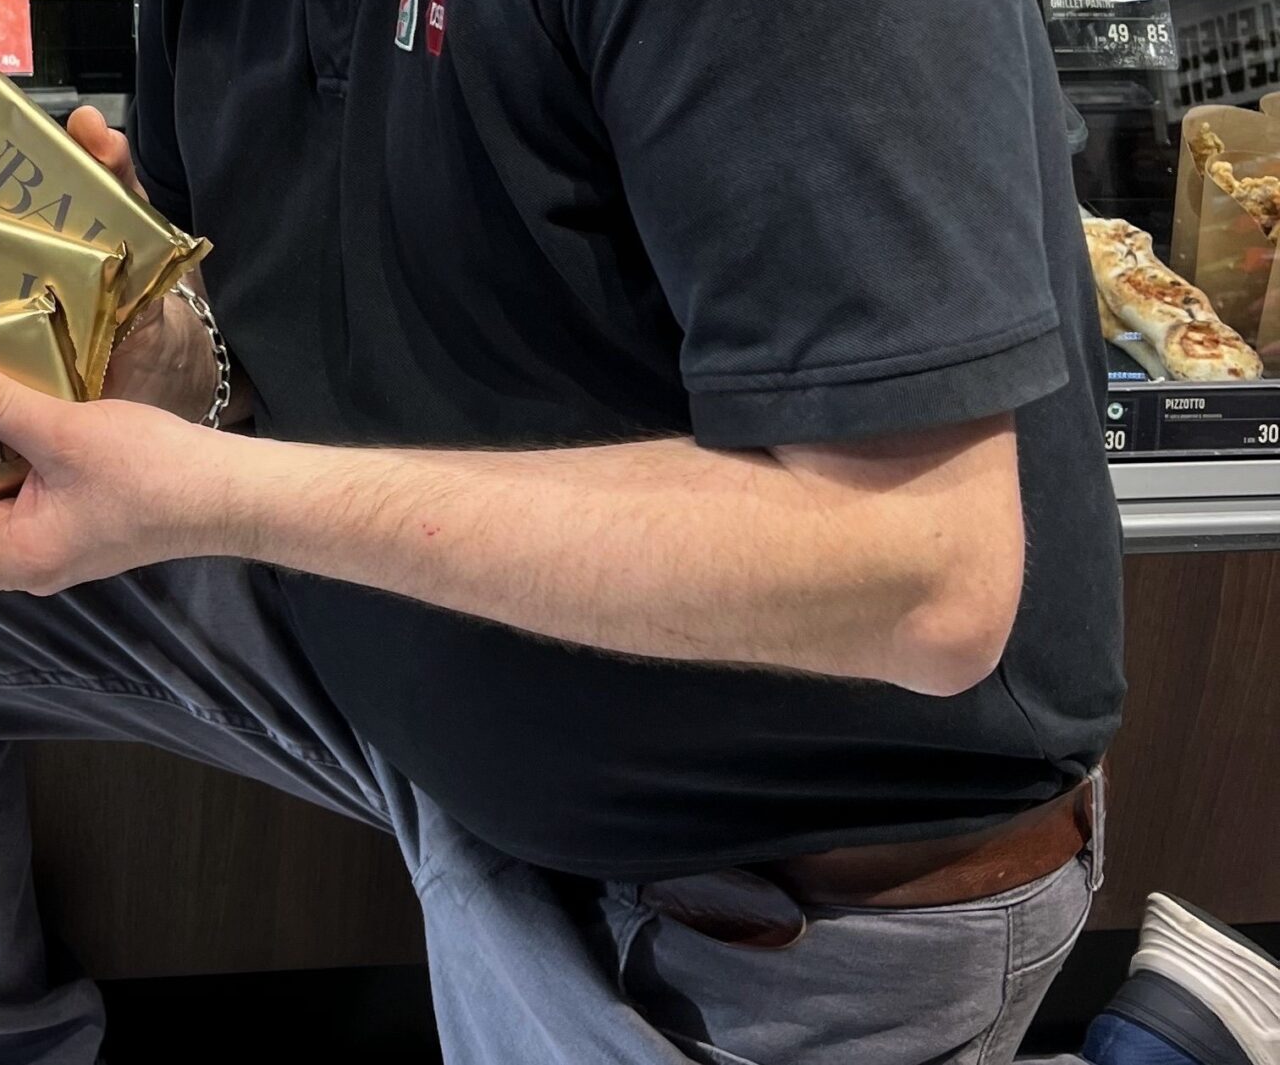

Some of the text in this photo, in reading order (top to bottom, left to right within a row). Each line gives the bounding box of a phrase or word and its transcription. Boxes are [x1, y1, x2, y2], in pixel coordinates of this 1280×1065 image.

[1107, 23, 1168, 42] 49 85
[1165, 398, 1206, 410] PIZZOTTO
[1105, 430, 1126, 450] 30
[1258, 423, 1279, 443] 30
